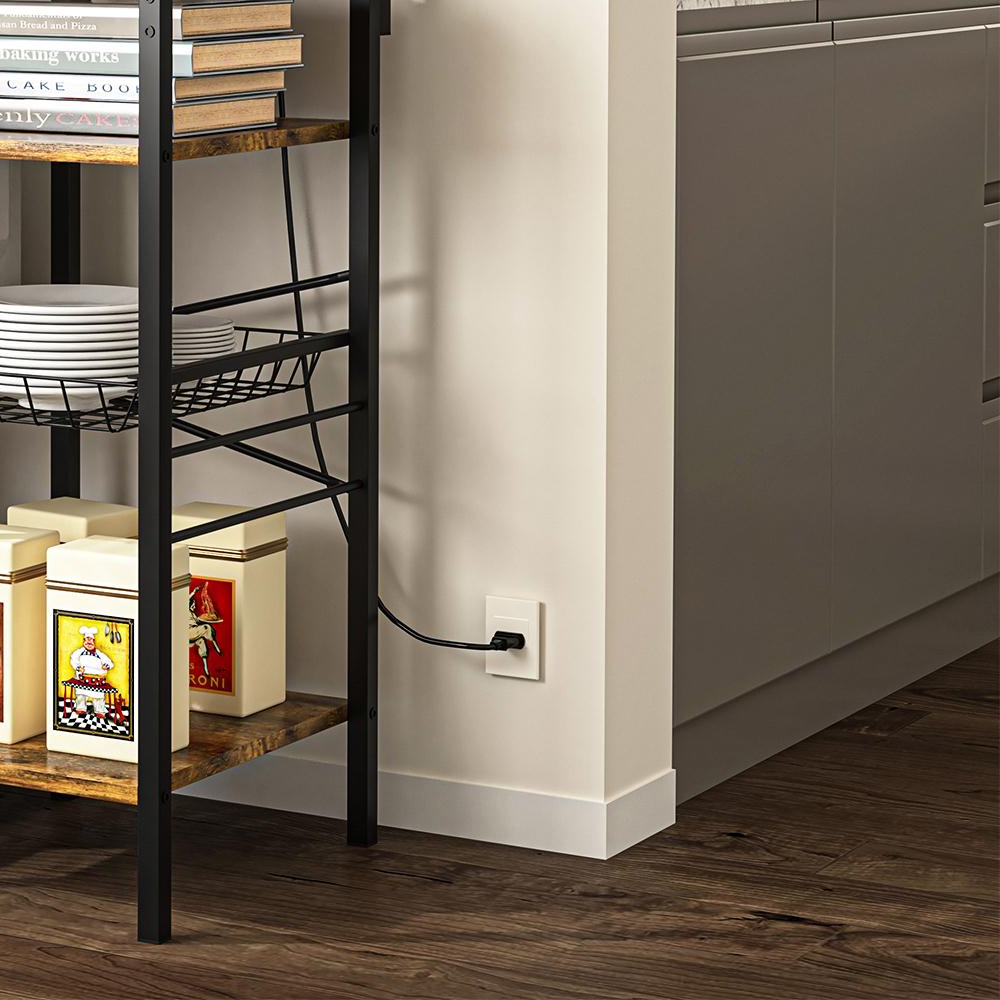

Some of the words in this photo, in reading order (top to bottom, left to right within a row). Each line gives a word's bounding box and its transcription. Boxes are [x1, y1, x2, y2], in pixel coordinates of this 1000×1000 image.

[20, 20, 48, 30] Bread
[50, 21, 68, 30] and
[71, 21, 97, 31] Pizza
[0, 47, 59, 66] baking
[65, 49, 120, 64] works
[7, 79, 65, 92] CAKE
[189, 674, 225, 688] RONI
